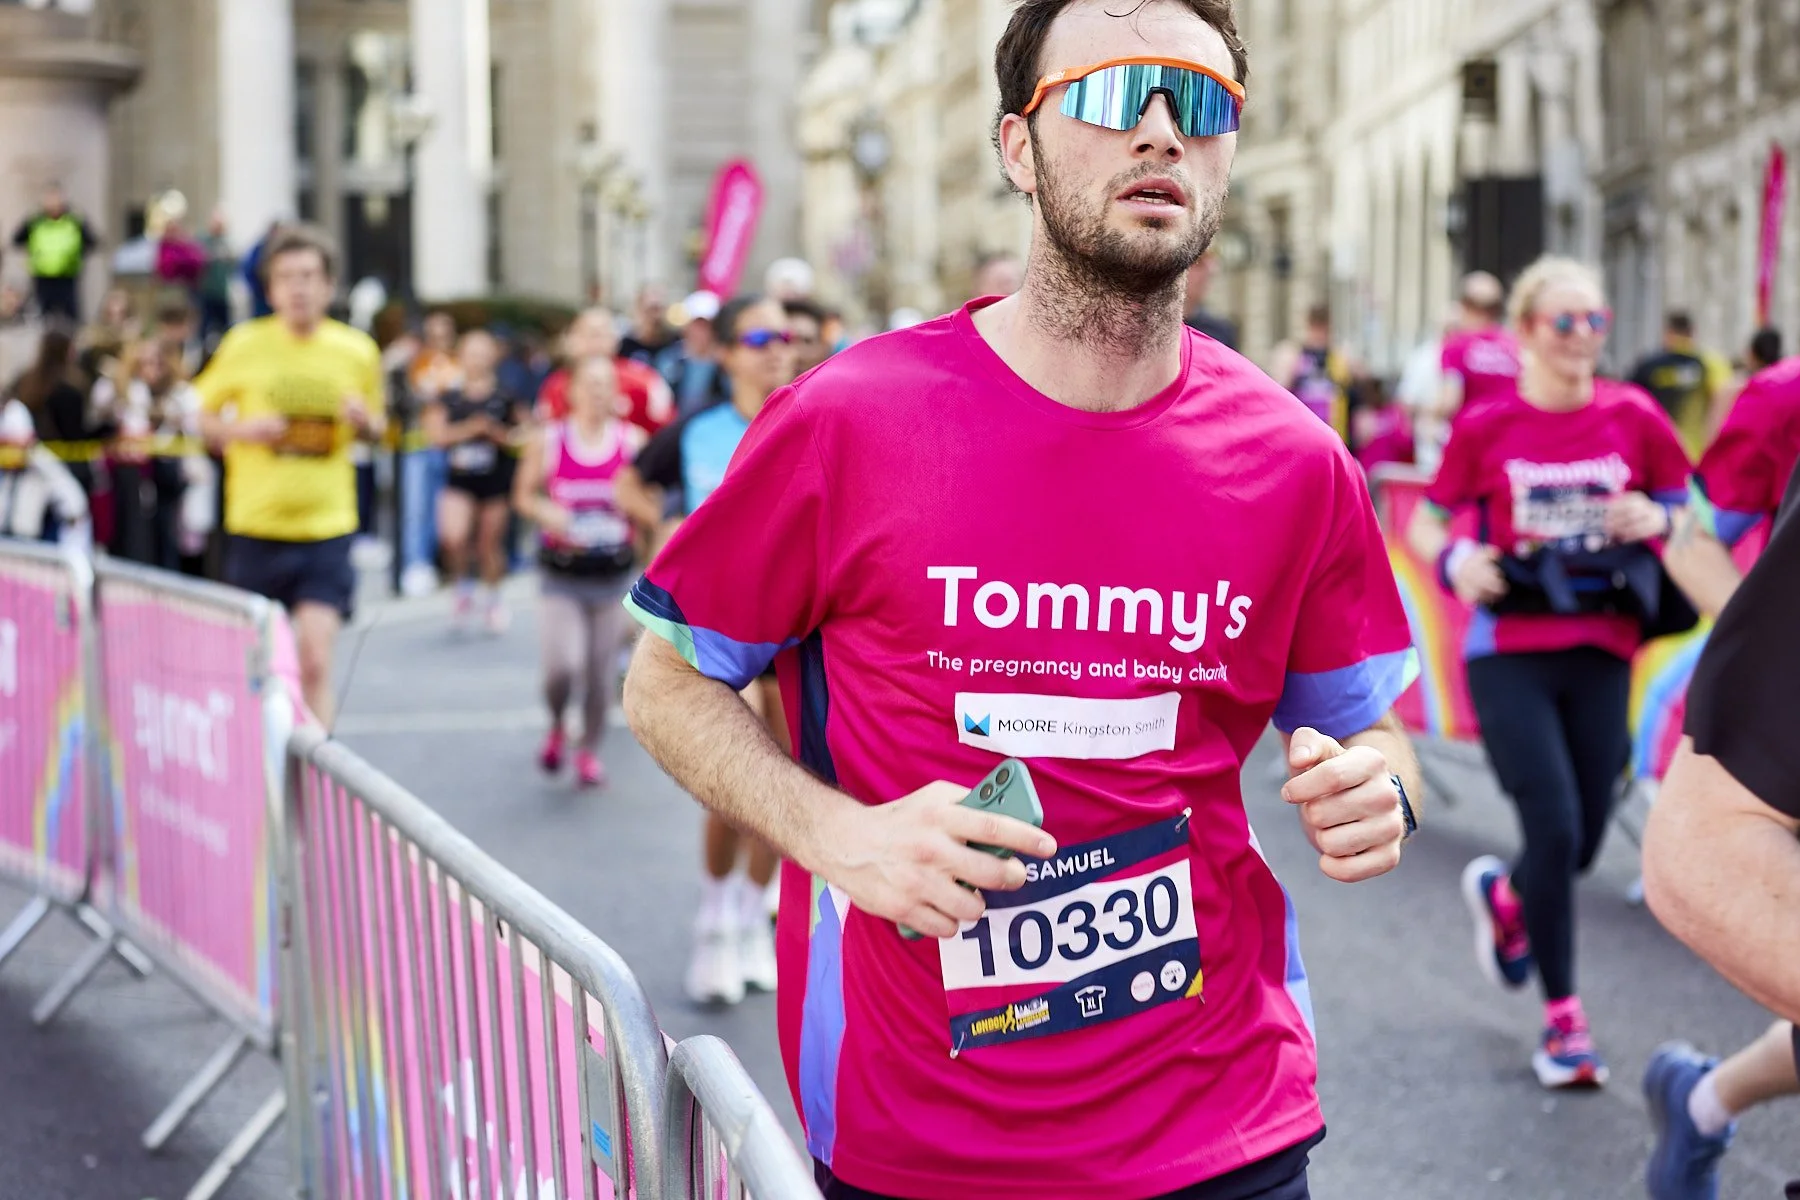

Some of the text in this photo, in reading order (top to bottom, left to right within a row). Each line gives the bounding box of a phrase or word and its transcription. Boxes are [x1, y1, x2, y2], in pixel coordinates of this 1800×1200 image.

[927, 566, 1252, 653] Tommy's
[926, 650, 963, 671] The
[970, 656, 1082, 680] pregnancy
[1088, 658, 1127, 678] and
[1133, 659, 1182, 683] baby
[998, 716, 1165, 738] MOORE Kingston Smith
[1025, 847, 1115, 882] SAMUEL
[961, 875, 1179, 978] 10330
[1087, 996, 1097, 1011] XL
[971, 1013, 1005, 1036] LONDON
